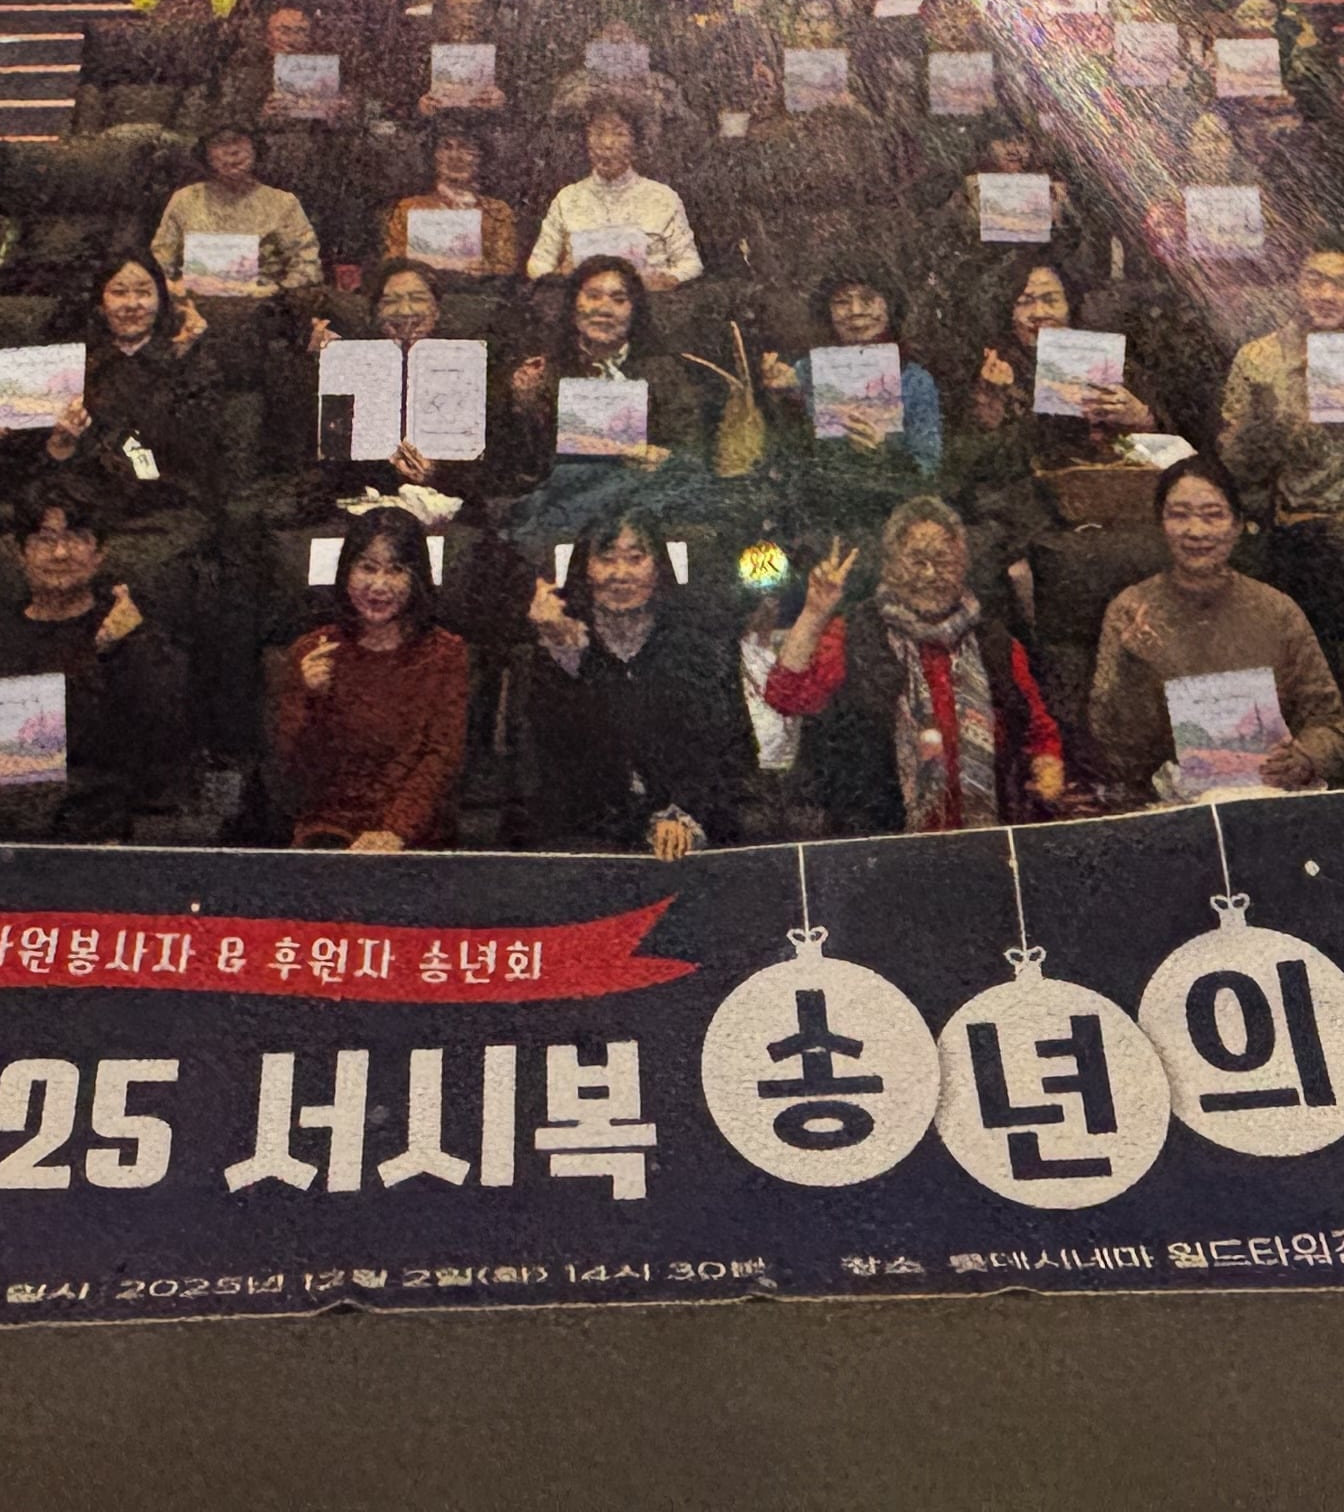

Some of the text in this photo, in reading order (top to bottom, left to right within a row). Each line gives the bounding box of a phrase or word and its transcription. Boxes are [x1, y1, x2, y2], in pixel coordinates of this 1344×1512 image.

[217, 941, 247, 974] &
[269, 938, 396, 984] 후원자
[418, 938, 544, 984] 송년회
[224, 1040, 657, 1200] 서시복
[757, 958, 1337, 1181] 송년의
